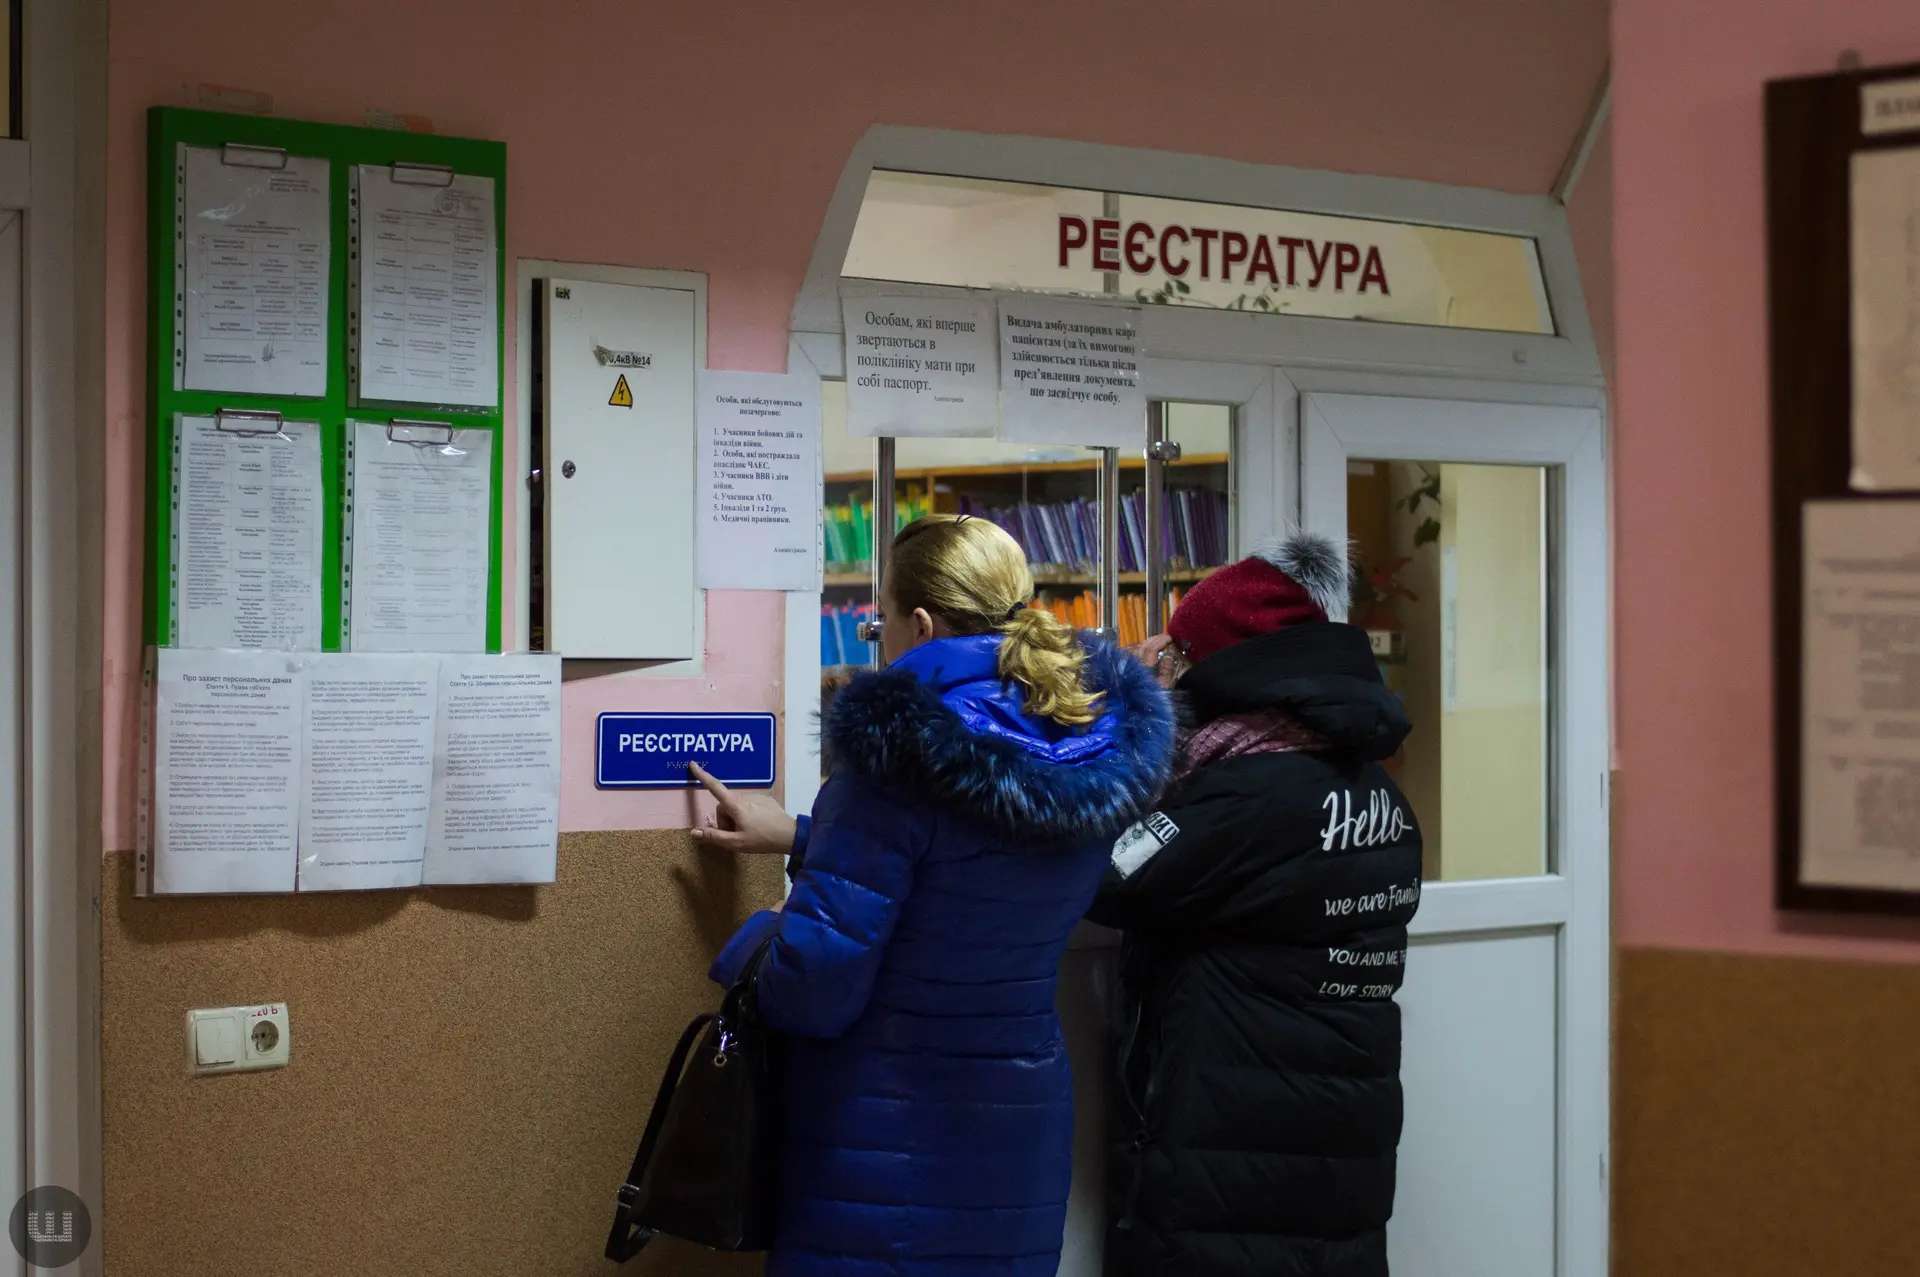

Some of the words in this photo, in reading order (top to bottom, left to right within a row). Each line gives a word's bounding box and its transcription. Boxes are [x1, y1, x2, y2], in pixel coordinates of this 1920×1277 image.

[1058, 213, 1391, 296] РЕЄСТРАТУРА
[865, 310, 913, 330] Особам,
[916, 315, 932, 330] які
[935, 319, 976, 335] вперше
[1006, 314, 1042, 329] Видача
[1045, 319, 1113, 337] амбулаторних
[1115, 327, 1137, 340] карт
[856, 334, 926, 350] звертаються
[929, 339, 936, 350] в
[1011, 334, 1061, 348] пацієнтам
[1063, 337, 1077, 350] (за
[1078, 338, 1087, 350] їх
[1089, 343, 1135, 356] вимогою)
[857, 352, 922, 373] поліклініку
[925, 359, 952, 372] мати
[955, 361, 976, 376] при
[1011, 350, 1076, 366] здійснюється
[1079, 355, 1110, 368] тільки
[1112, 358, 1137, 371] після
[857, 373, 881, 388] собі
[884, 377, 932, 394] паспорт.
[1084, 374, 1136, 388] документа,
[741, 396, 751, 404] які
[1029, 387, 1045, 399] що
[1047, 388, 1092, 403] засвідчує
[1093, 391, 1121, 405] особу.
[714, 427, 719, 436] 1.
[723, 428, 756, 437] Учасники
[757, 429, 783, 438] бойових
[785, 430, 795, 439] дій
[713, 449, 719, 457] 2.
[746, 450, 757, 459] які
[713, 470, 719, 479] 3.
[721, 471, 754, 480] Учасники
[755, 472, 771, 480] ВВВ
[775, 472, 789, 481] діти
[713, 492, 719, 501] 4.
[721, 492, 755, 501] Учасники
[713, 503, 719, 511] 5.
[721, 514, 750, 522] Медичні
[751, 515, 791, 525] працівники.
[183, 674, 197, 683] Про
[198, 675, 221, 683] захист
[619, 733, 755, 752] РЕЄСТРАТУРА
[1320, 788, 1413, 852] Hello
[1324, 896, 1356, 917] we
[1358, 891, 1388, 914] are
[1328, 947, 1360, 966] YOU
[1360, 951, 1385, 967] AND
[1319, 981, 1358, 998] LOVE
[1359, 984, 1394, 998] STORY
